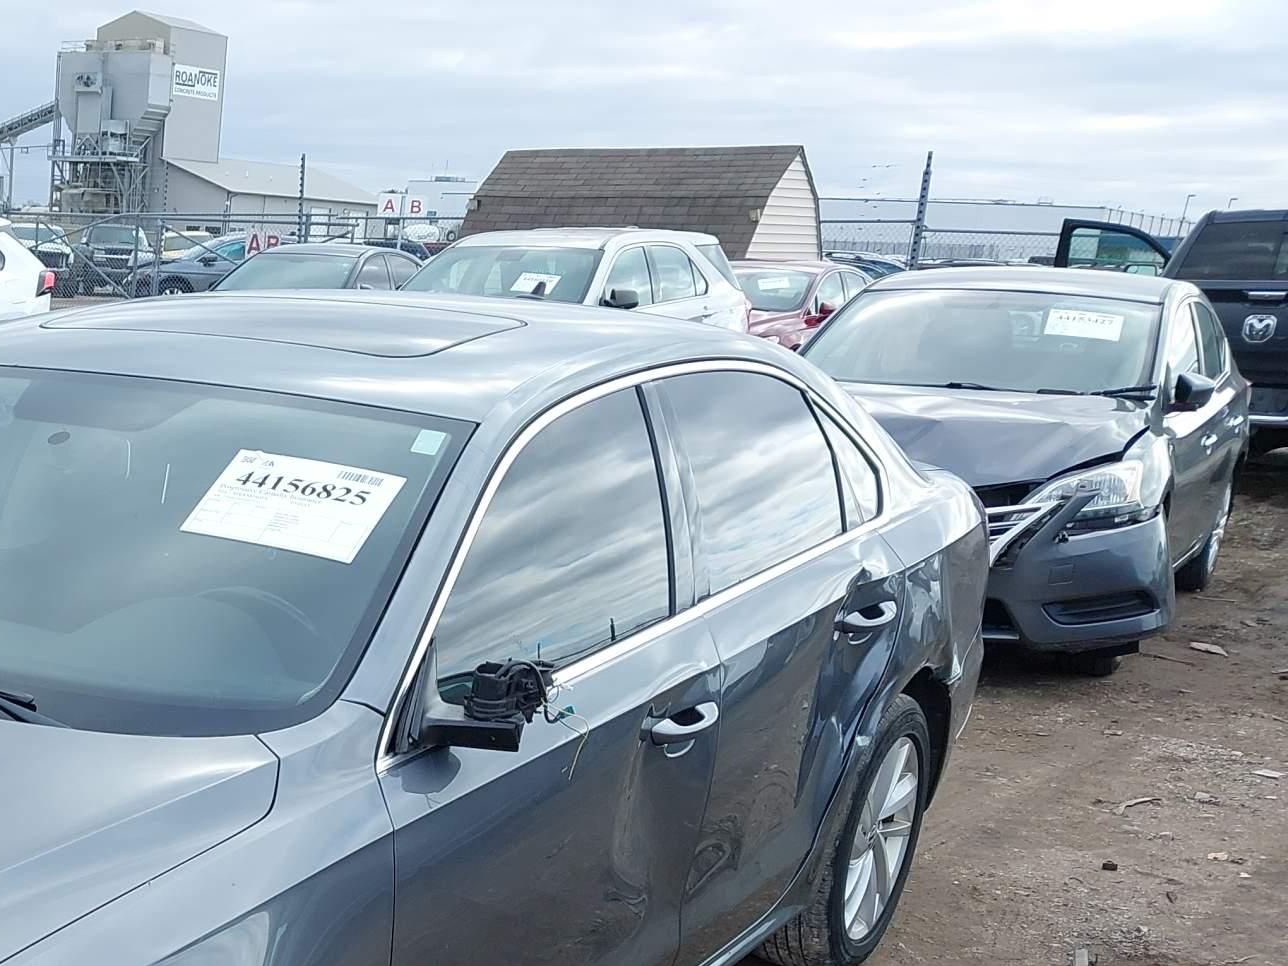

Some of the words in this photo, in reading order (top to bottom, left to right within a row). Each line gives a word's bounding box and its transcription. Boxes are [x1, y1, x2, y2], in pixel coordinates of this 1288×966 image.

[175, 70, 218, 87] ROANOKE
[383, 199, 394, 212] A
[410, 199, 421, 213] B
[247, 233, 260, 254] A
[235, 470, 371, 506] 44156825
